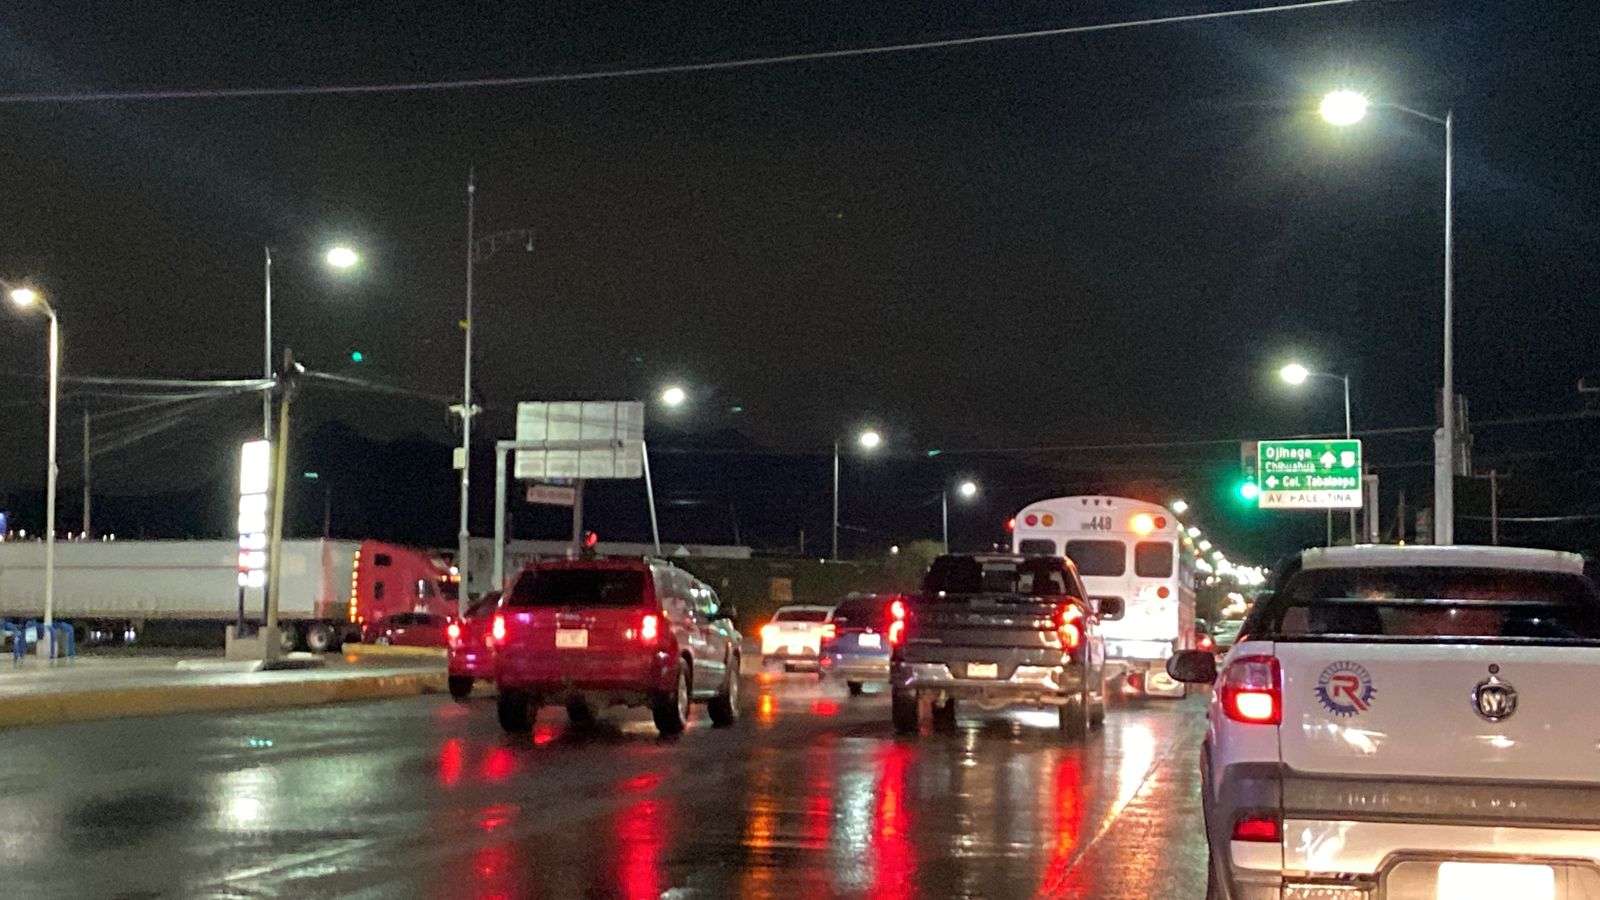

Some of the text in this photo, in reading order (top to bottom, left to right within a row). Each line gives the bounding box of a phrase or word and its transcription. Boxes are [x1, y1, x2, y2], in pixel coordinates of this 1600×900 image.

[1265, 447, 1312, 461] Ojinaga
[1265, 461, 1316, 473] Chihuahua
[1290, 493, 1352, 503] PALETINA
[1090, 516, 1112, 530] 448
[1331, 675, 1368, 712] R
